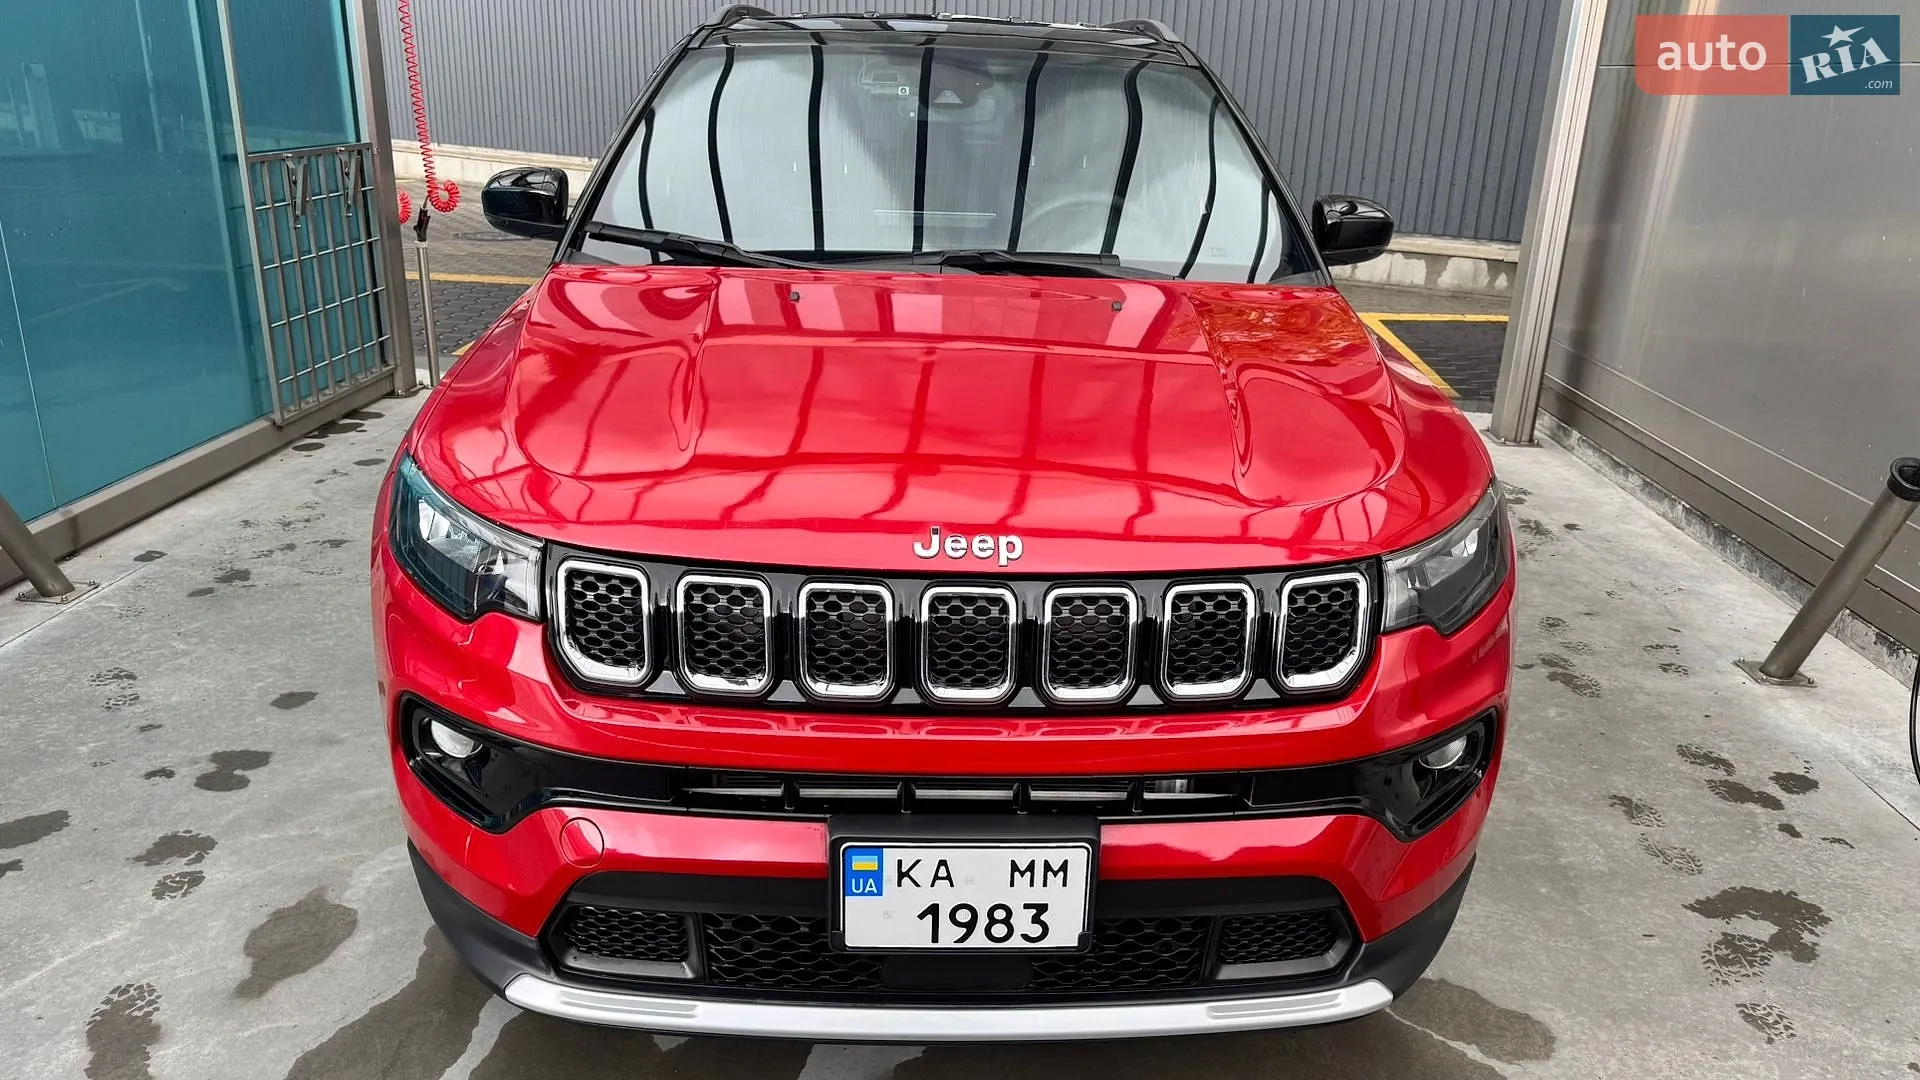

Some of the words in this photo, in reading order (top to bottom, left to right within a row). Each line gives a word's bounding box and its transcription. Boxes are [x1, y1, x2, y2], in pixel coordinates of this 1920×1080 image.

[912, 526, 1024, 567] Jeep
[851, 878, 878, 894] UA
[897, 858, 955, 888] KA
[1009, 858, 1069, 888] MM
[916, 902, 1050, 944] 1983
